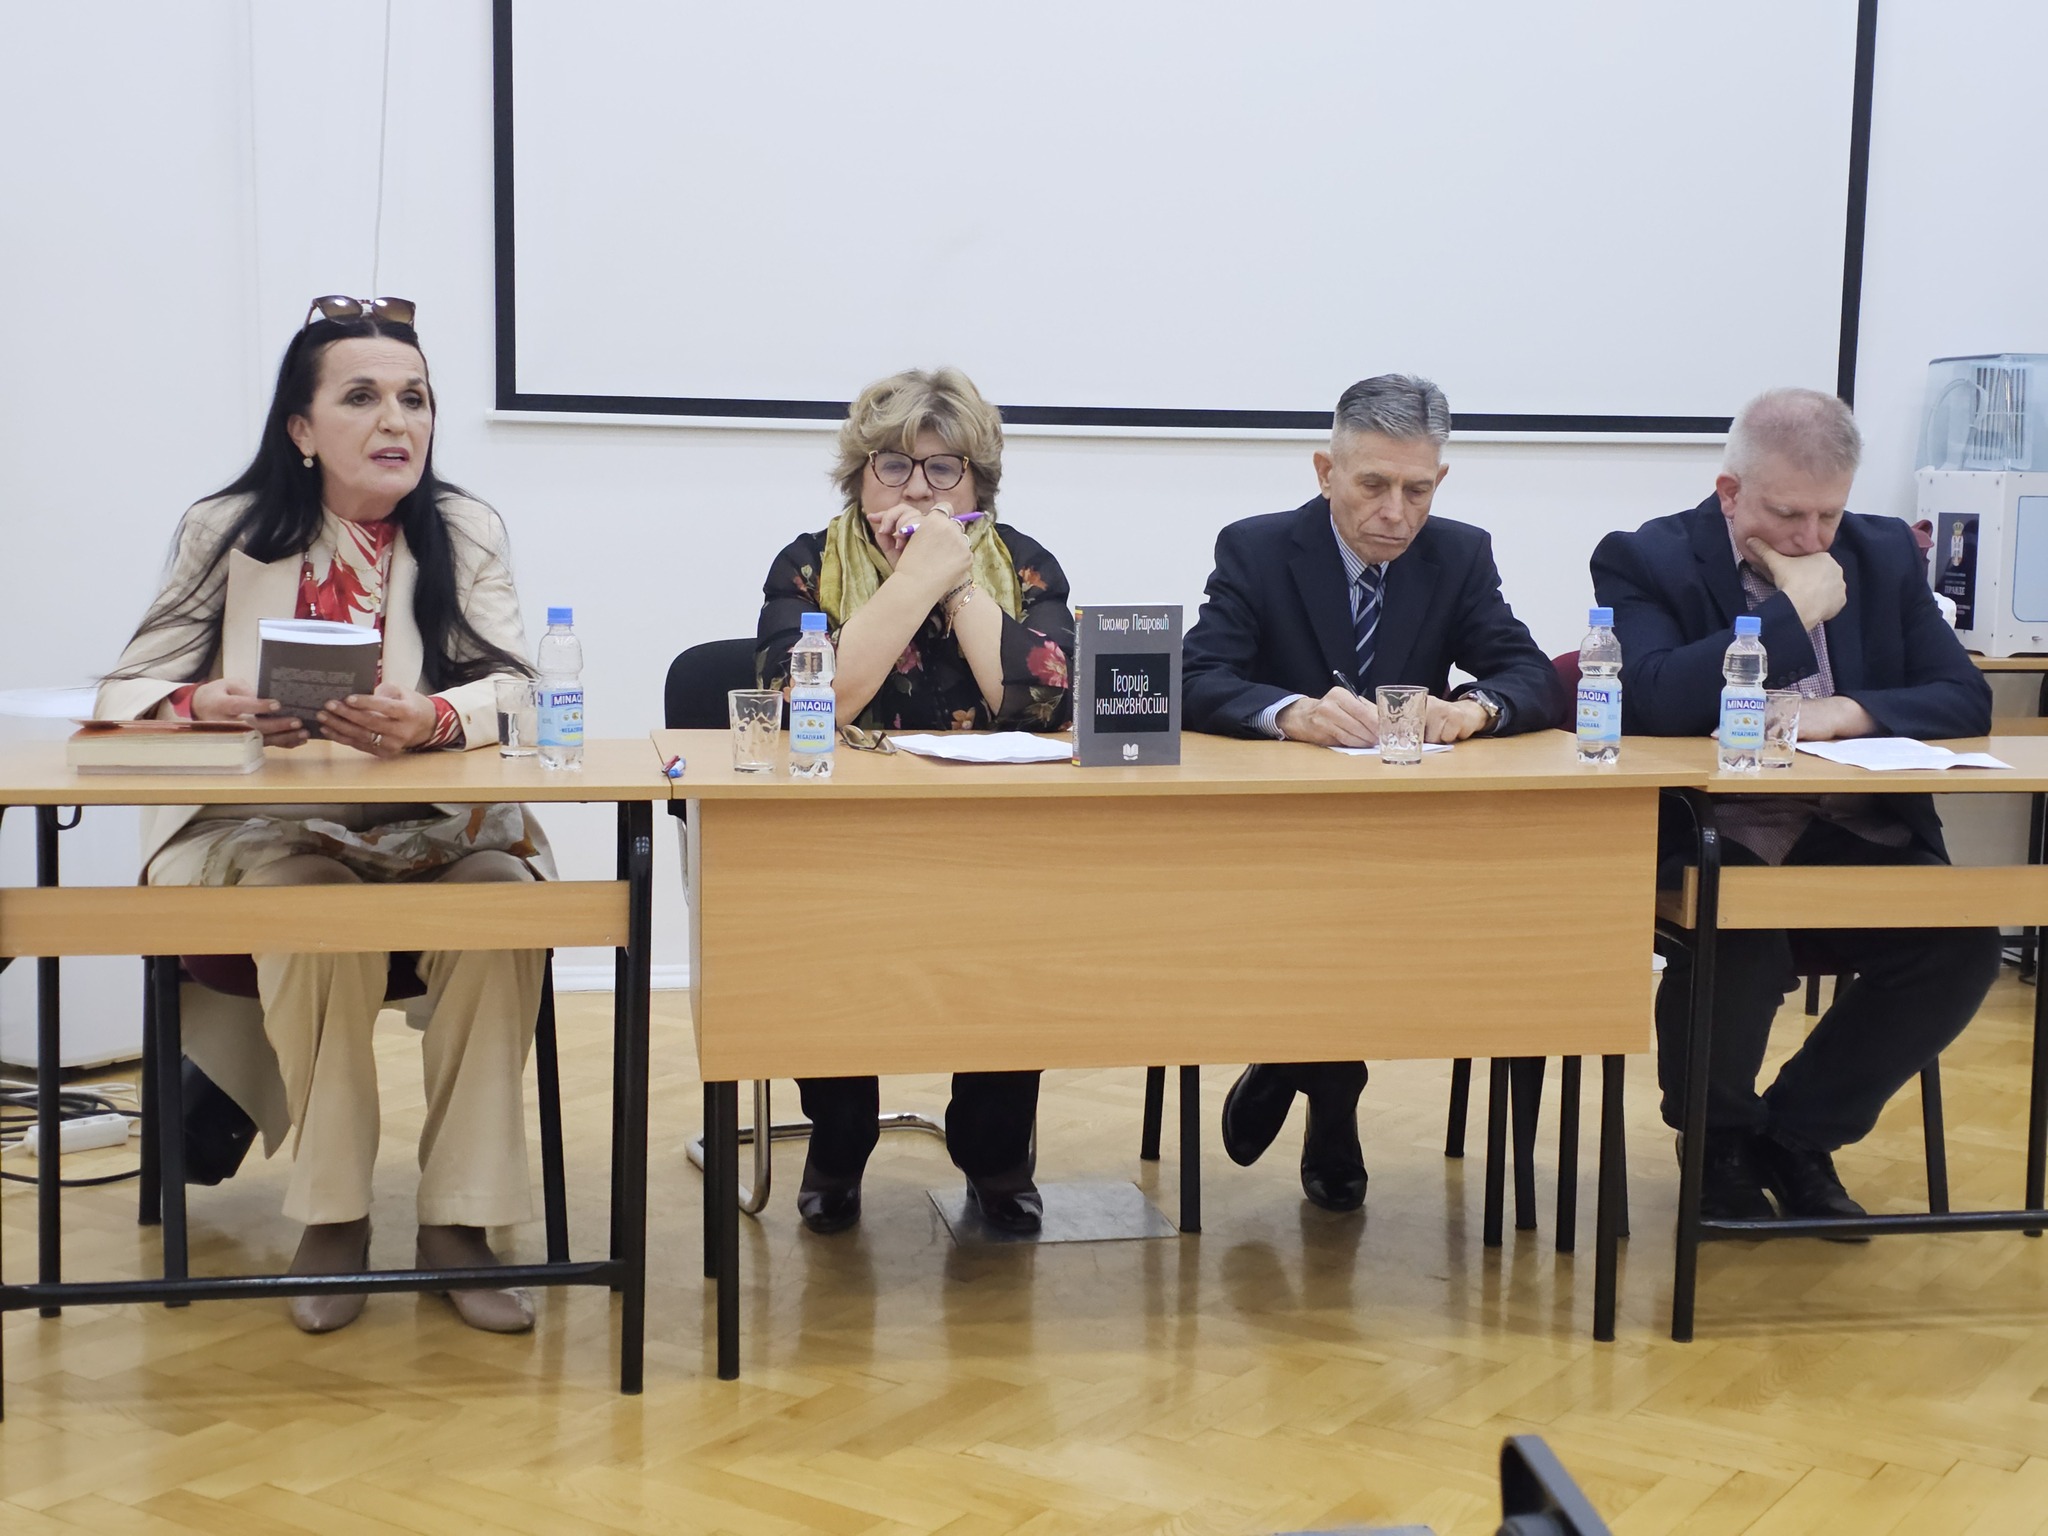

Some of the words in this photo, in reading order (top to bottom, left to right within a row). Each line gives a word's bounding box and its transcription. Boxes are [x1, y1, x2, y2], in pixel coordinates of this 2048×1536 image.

[1097, 613, 1130, 635] Тихомир
[1110, 668, 1149, 698] Теорија
[792, 701, 832, 712] MINAQUA
[1727, 700, 1765, 710] MINAQUA
